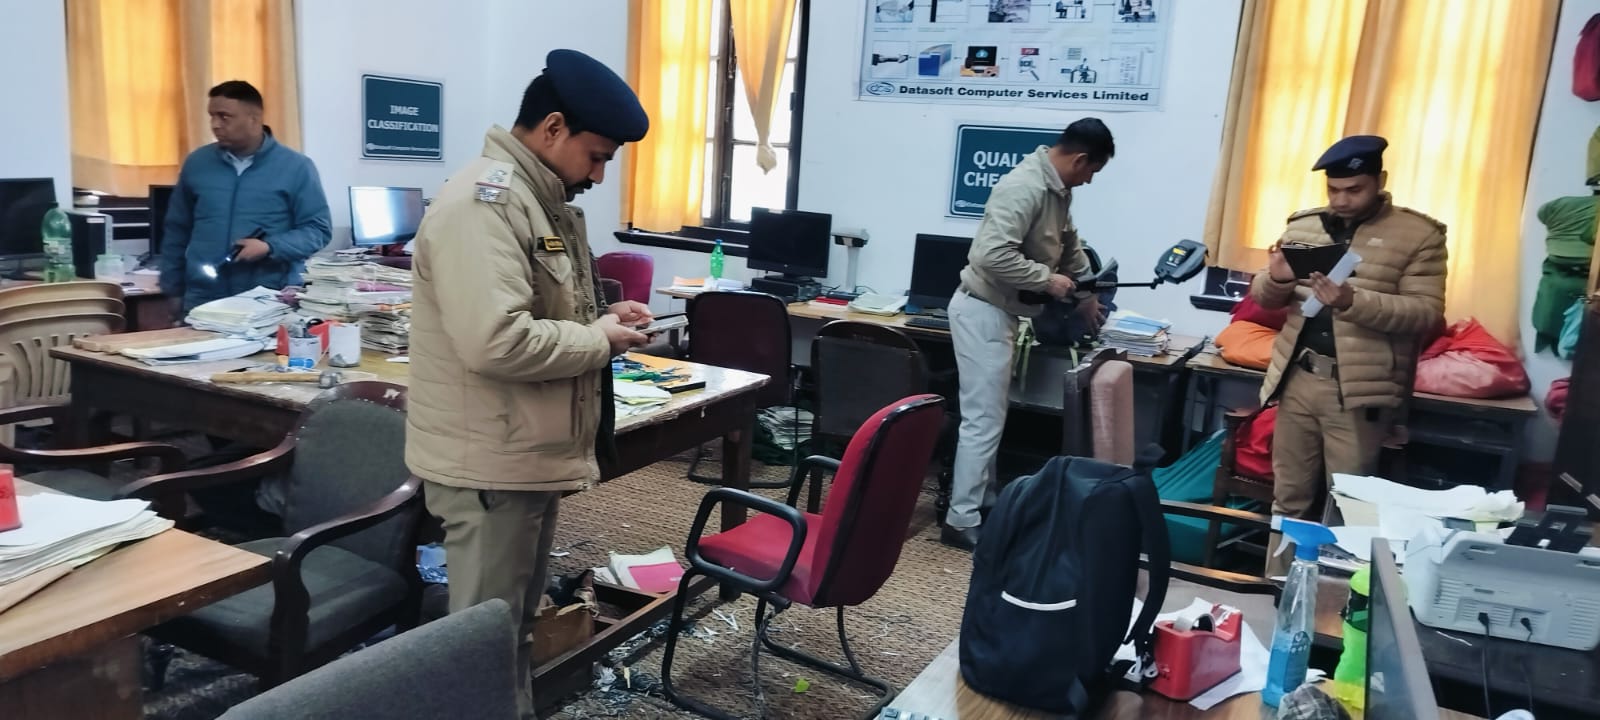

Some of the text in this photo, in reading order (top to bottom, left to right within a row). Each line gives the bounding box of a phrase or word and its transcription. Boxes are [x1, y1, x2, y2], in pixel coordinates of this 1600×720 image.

[899, 85, 954, 96] Datasoft
[957, 87, 1023, 98] Computer
[1027, 89, 1088, 100] Services
[1093, 90, 1149, 101] Limited
[390, 104, 420, 116] IMAGE
[367, 119, 439, 133] CLASSIFICATION
